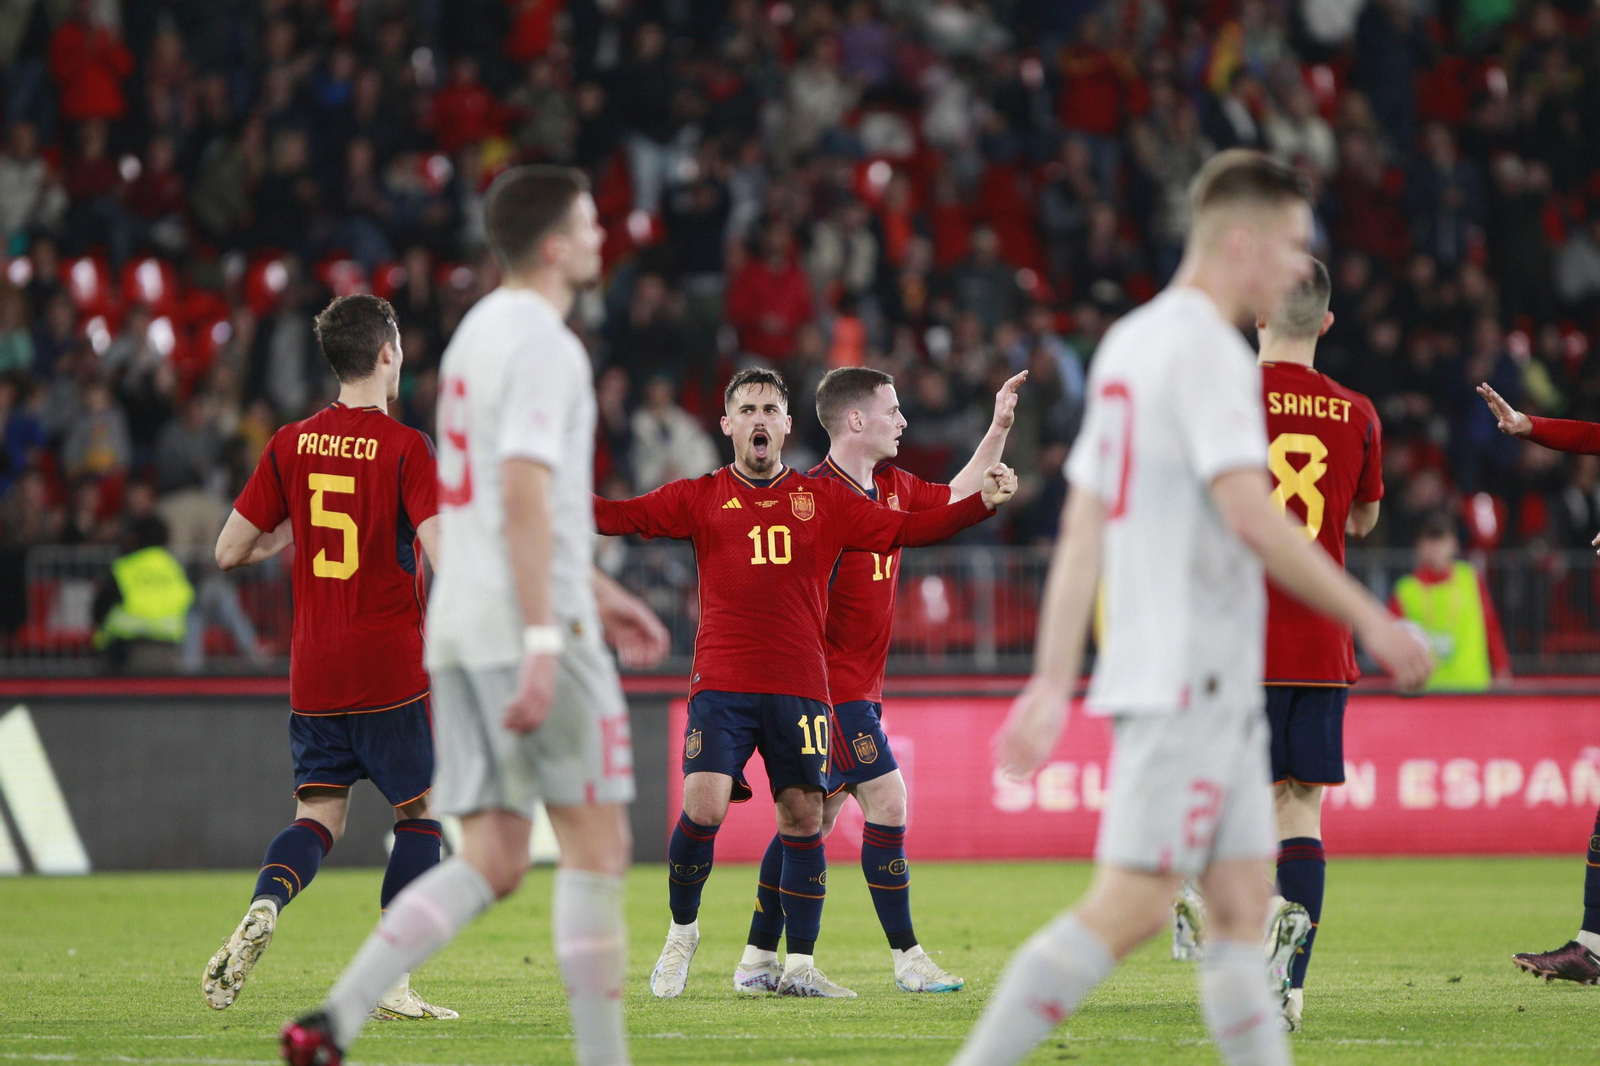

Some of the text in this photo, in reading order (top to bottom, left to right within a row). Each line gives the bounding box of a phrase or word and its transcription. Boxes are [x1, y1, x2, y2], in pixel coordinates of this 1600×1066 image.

[1267, 391, 1352, 424] SANCET
[297, 432, 379, 461] PACHECO
[1267, 432, 1329, 544] 8
[308, 472, 360, 581] 5
[747, 525, 792, 565] 10
[797, 714, 829, 756] 10
